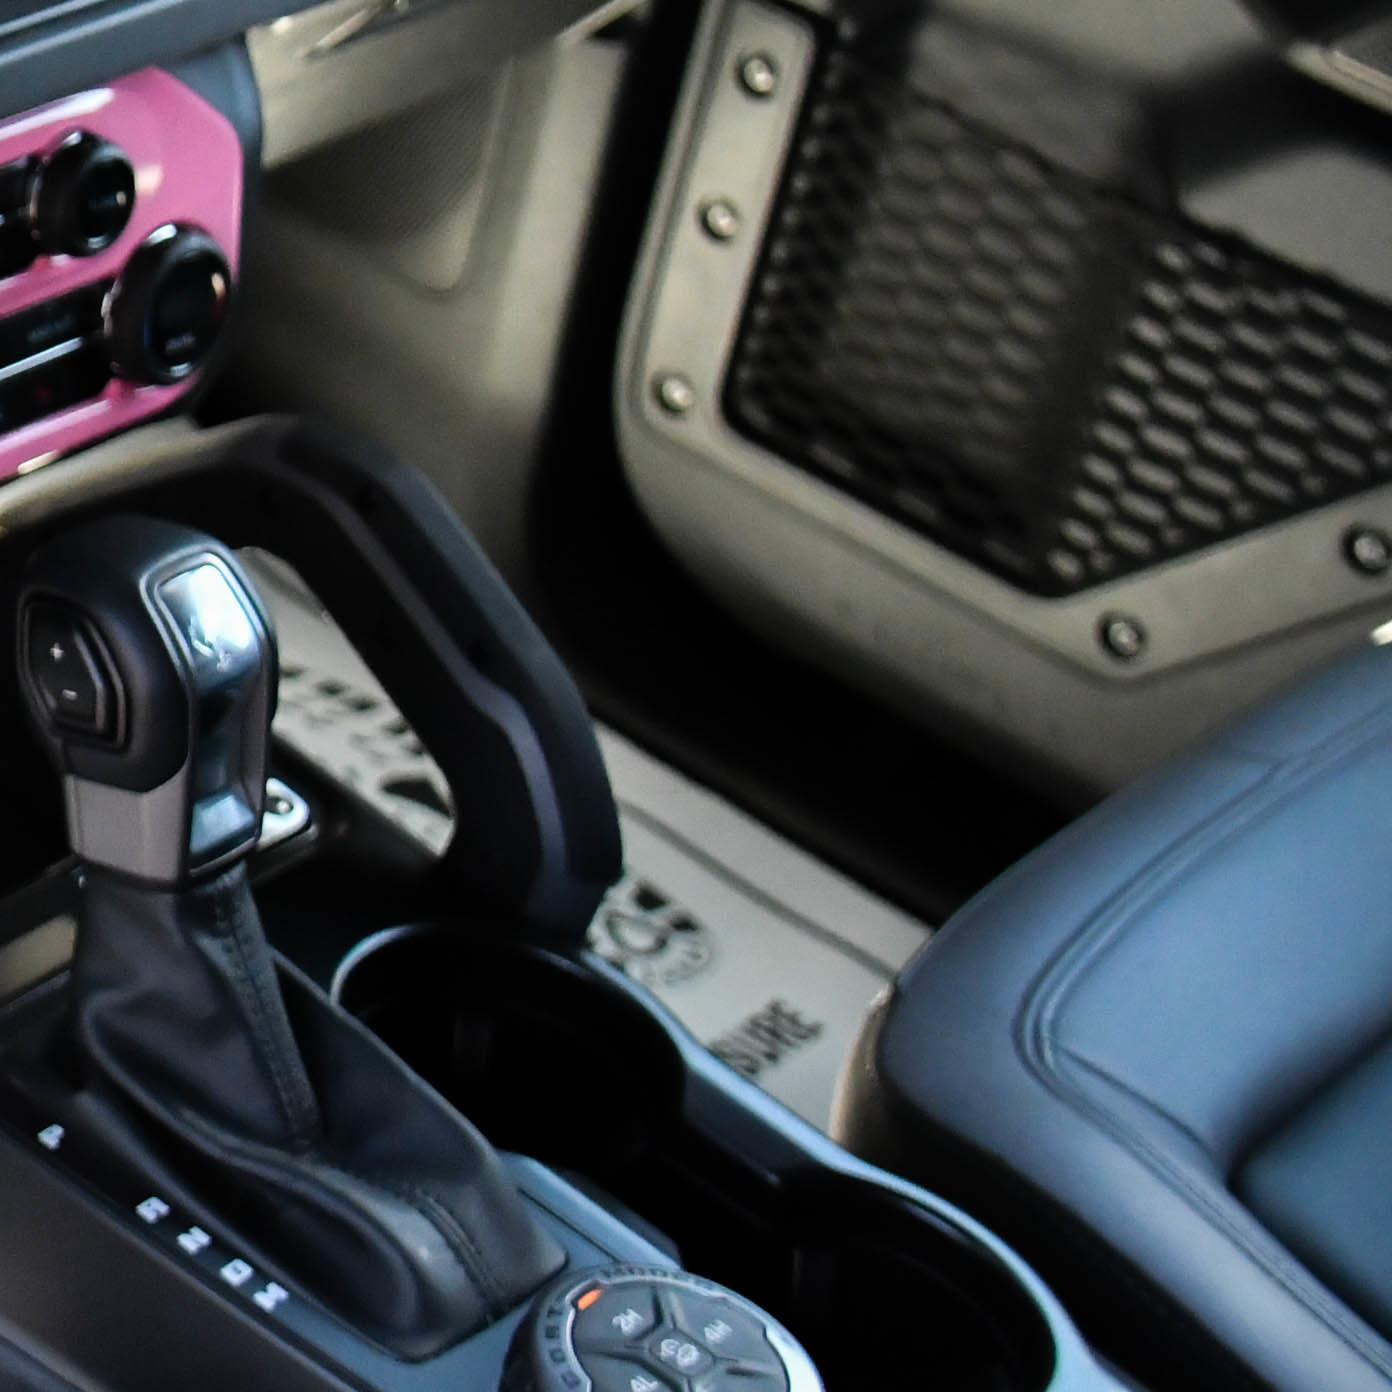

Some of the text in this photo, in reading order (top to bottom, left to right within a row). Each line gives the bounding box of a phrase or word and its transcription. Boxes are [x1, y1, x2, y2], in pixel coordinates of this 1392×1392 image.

[38, 1123, 65, 1150] P
[135, 1196, 170, 1224] R
[177, 1226, 212, 1255] N
[220, 1258, 254, 1288] D
[612, 1308, 644, 1337] 2H
[703, 1319, 733, 1344] 4H
